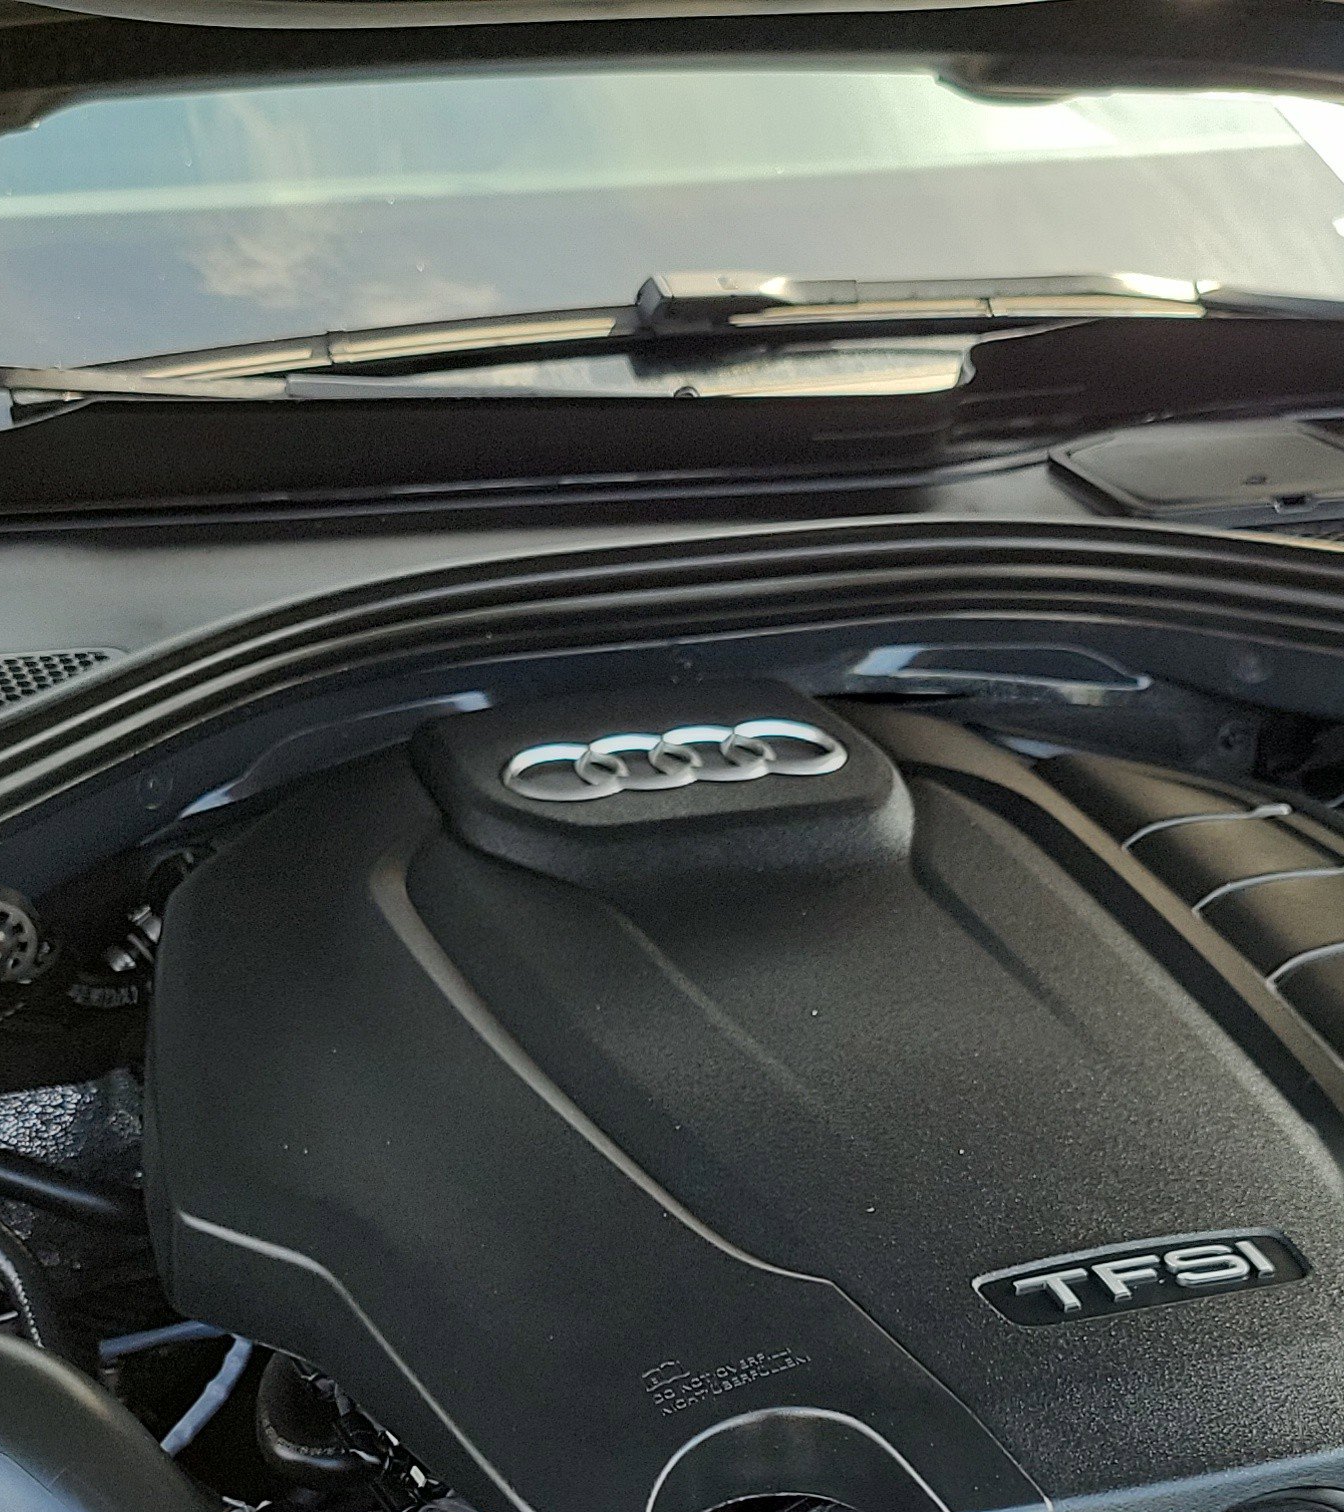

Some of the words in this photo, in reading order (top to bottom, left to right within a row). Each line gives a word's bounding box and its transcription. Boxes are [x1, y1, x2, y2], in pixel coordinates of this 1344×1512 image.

[1013, 1239, 1275, 1313] TFSI
[654, 1388, 676, 1405] DO
[681, 1373, 711, 1394] NOT
